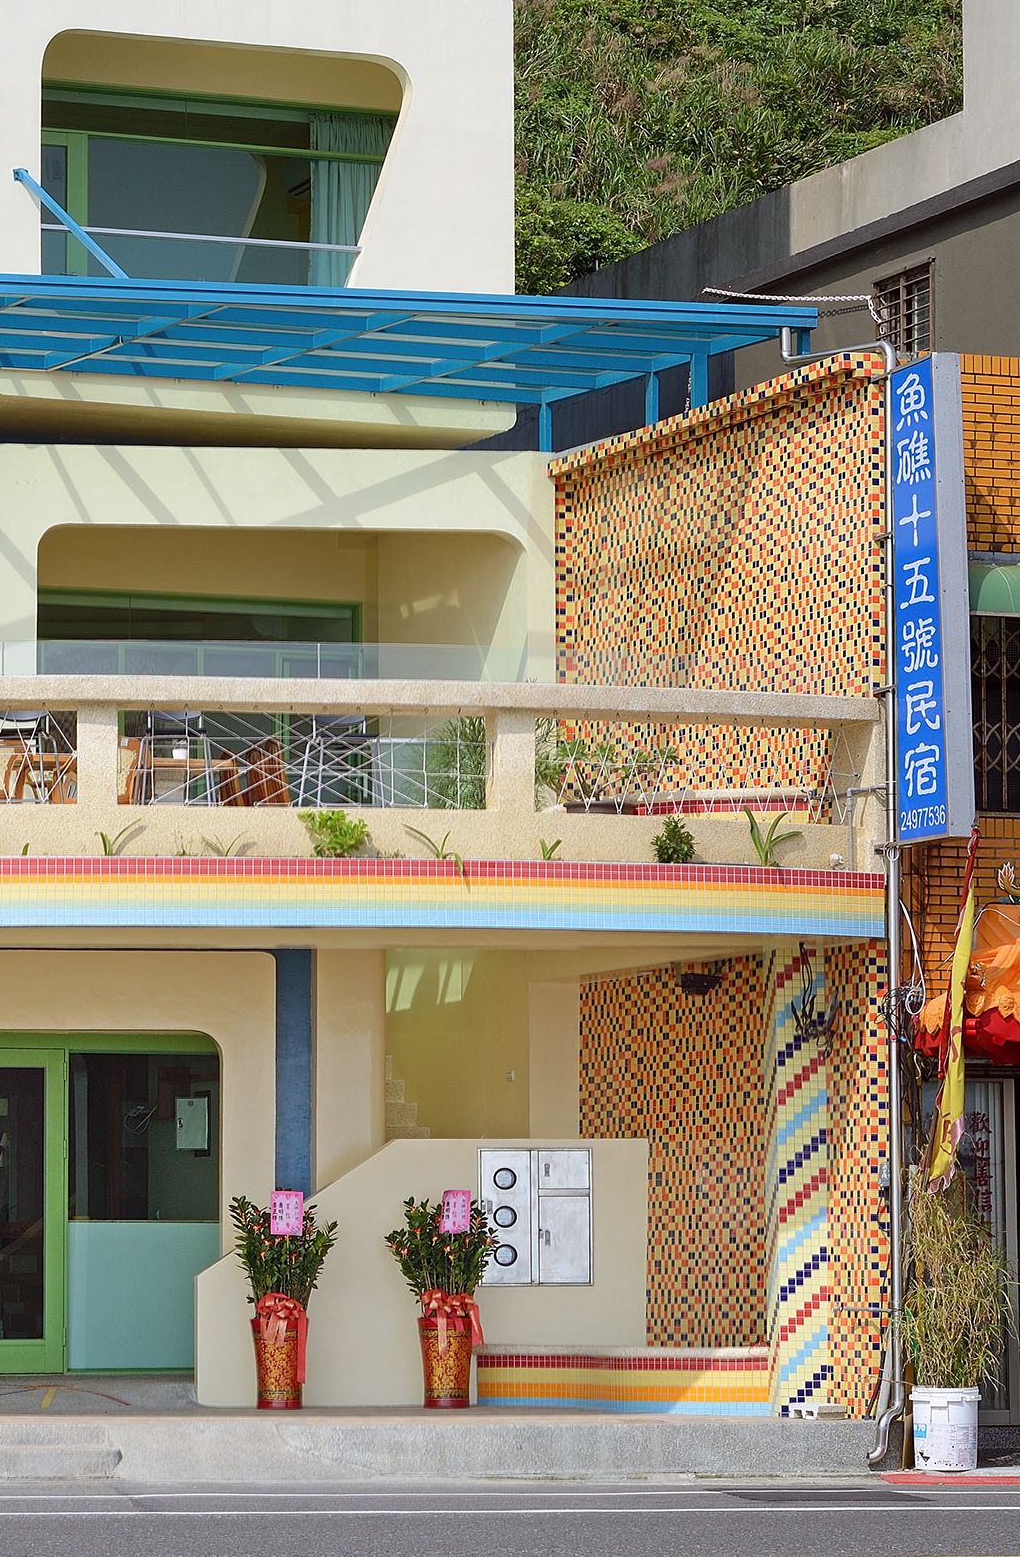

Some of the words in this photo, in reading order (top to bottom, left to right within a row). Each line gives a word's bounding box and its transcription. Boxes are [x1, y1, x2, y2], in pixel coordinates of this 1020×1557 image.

[896, 373, 940, 798] 魚礁十五號民宿
[901, 804, 946, 831] 24977536
